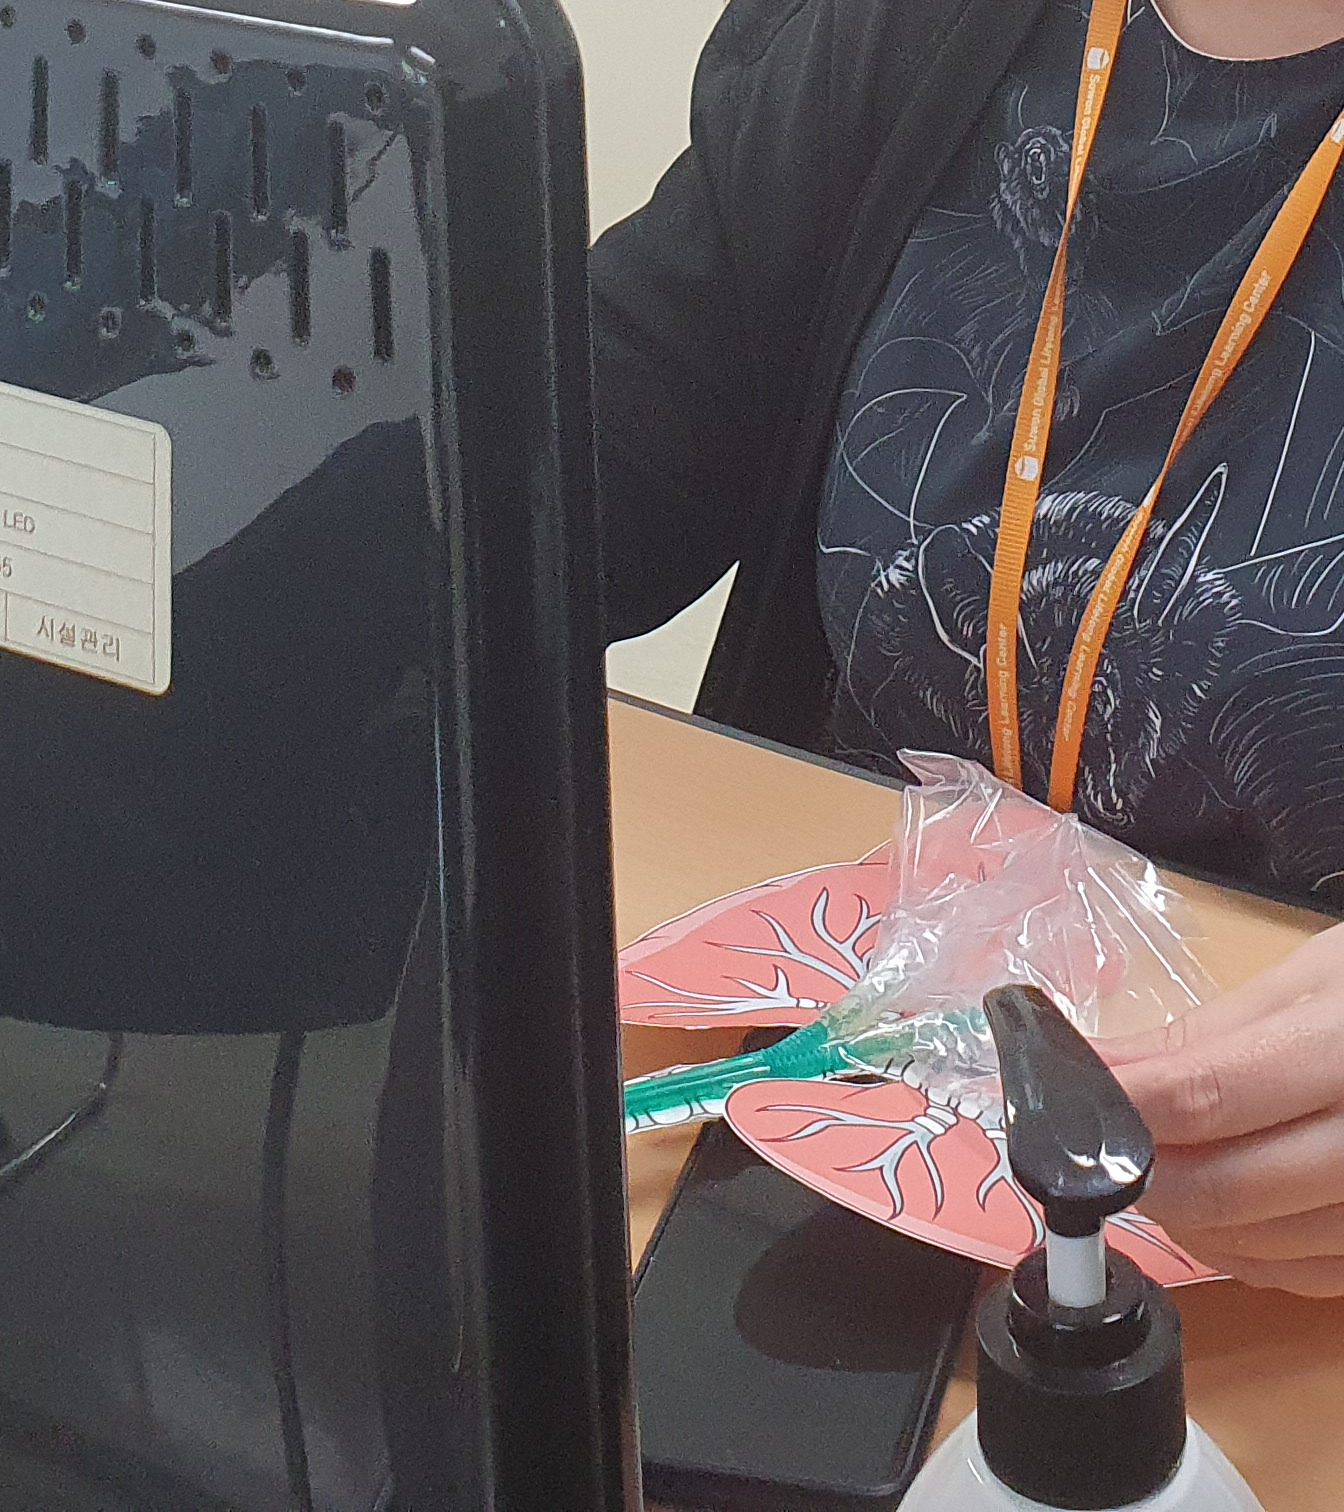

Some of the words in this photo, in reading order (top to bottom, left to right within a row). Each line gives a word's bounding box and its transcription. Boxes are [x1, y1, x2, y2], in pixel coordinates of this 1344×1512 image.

[1216, 312, 1250, 366] Learning
[1244, 269, 1271, 312] Center
[3, 509, 36, 534] LED
[37, 614, 121, 662] 시설관리
[996, 623, 1007, 665] Center
[997, 670, 1009, 723] Learning
